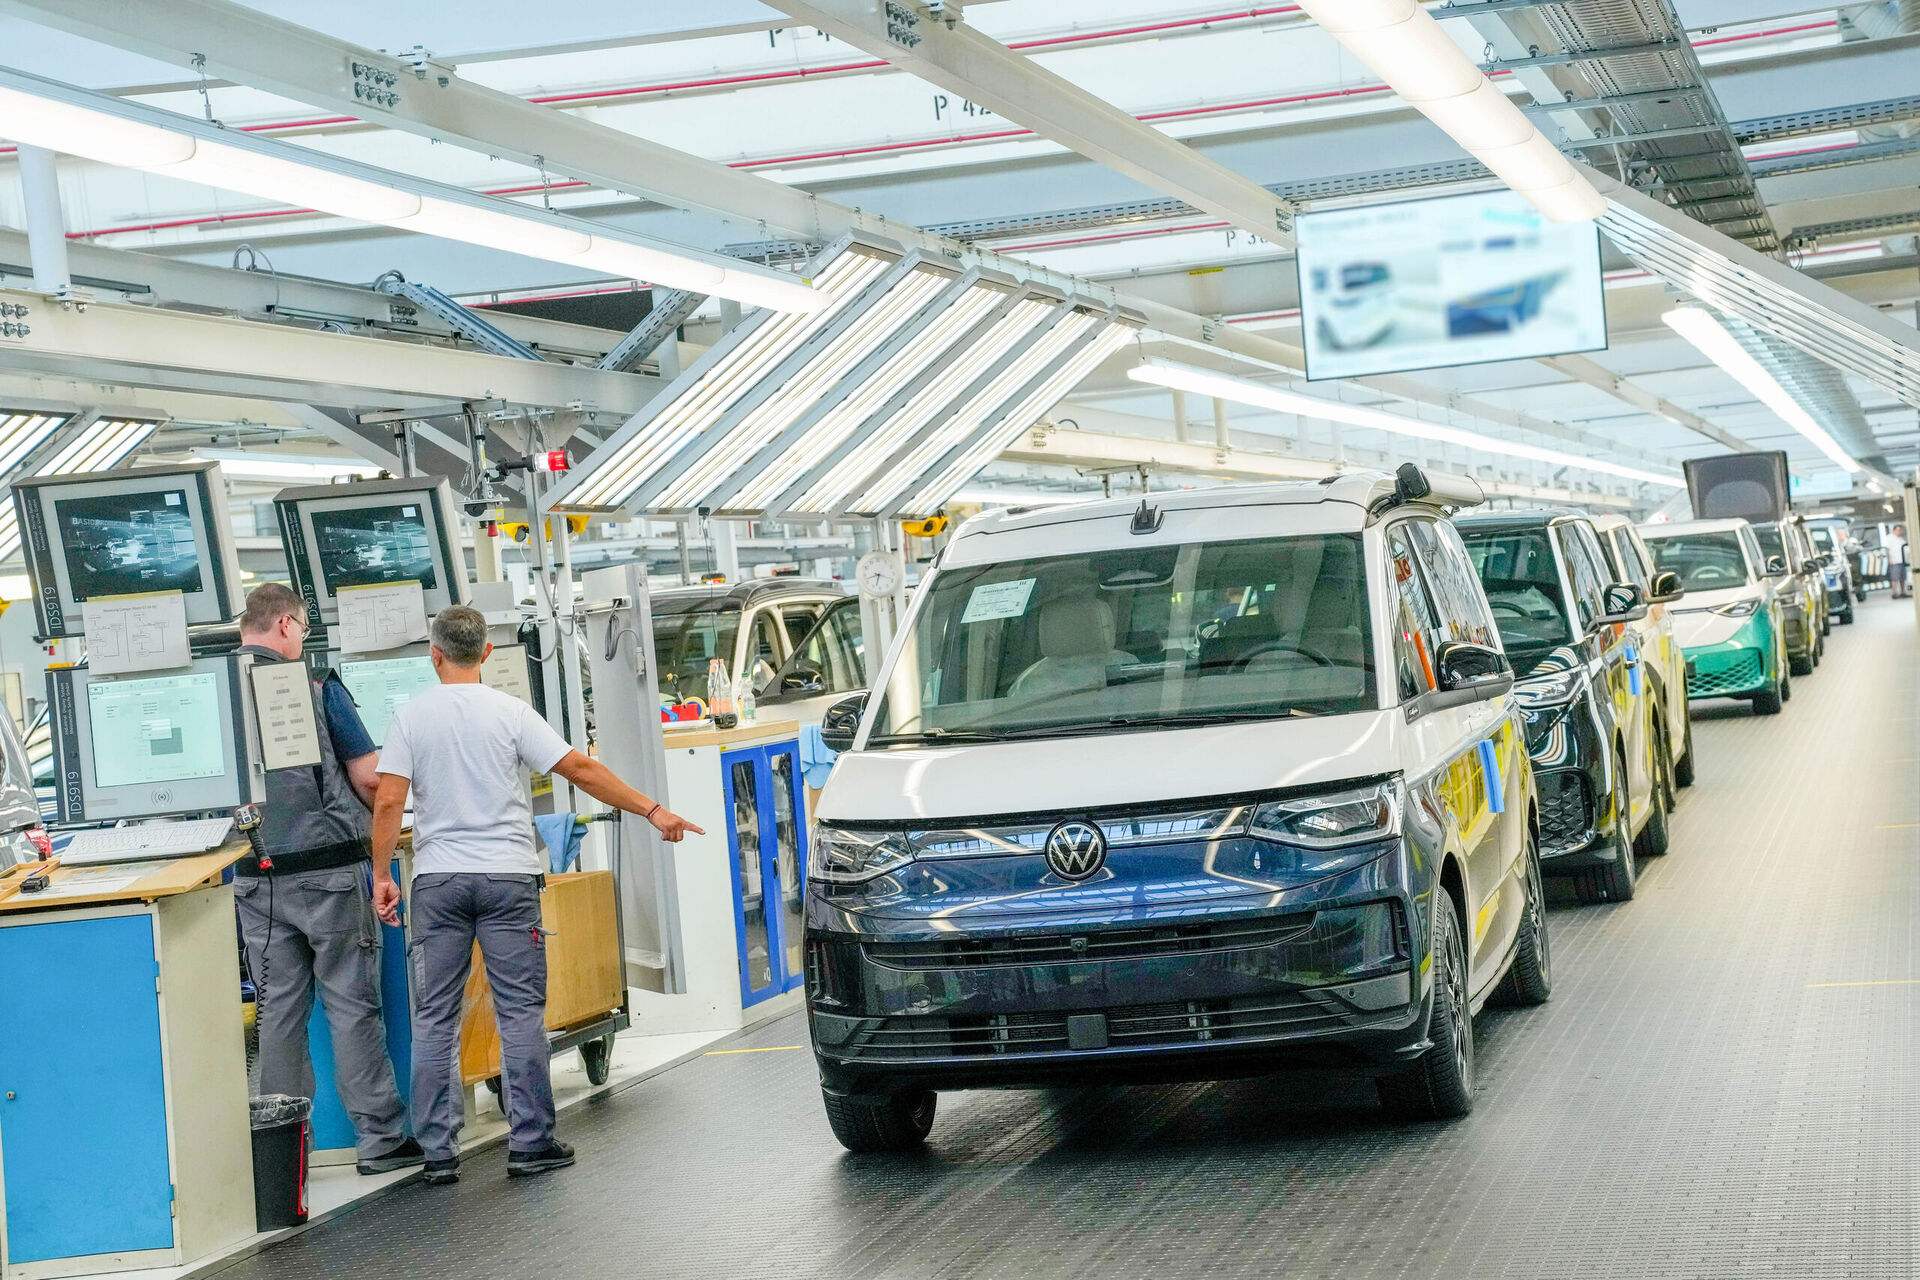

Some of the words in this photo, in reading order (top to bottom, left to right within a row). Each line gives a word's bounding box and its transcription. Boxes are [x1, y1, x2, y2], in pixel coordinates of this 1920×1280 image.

[934, 95, 948, 121] P
[1226, 230, 1236, 248] P
[44, 586, 63, 629] IDS919
[303, 584, 319, 620] IDS919
[67, 771, 82, 815] IDS919
[1048, 823, 1102, 877] VW
